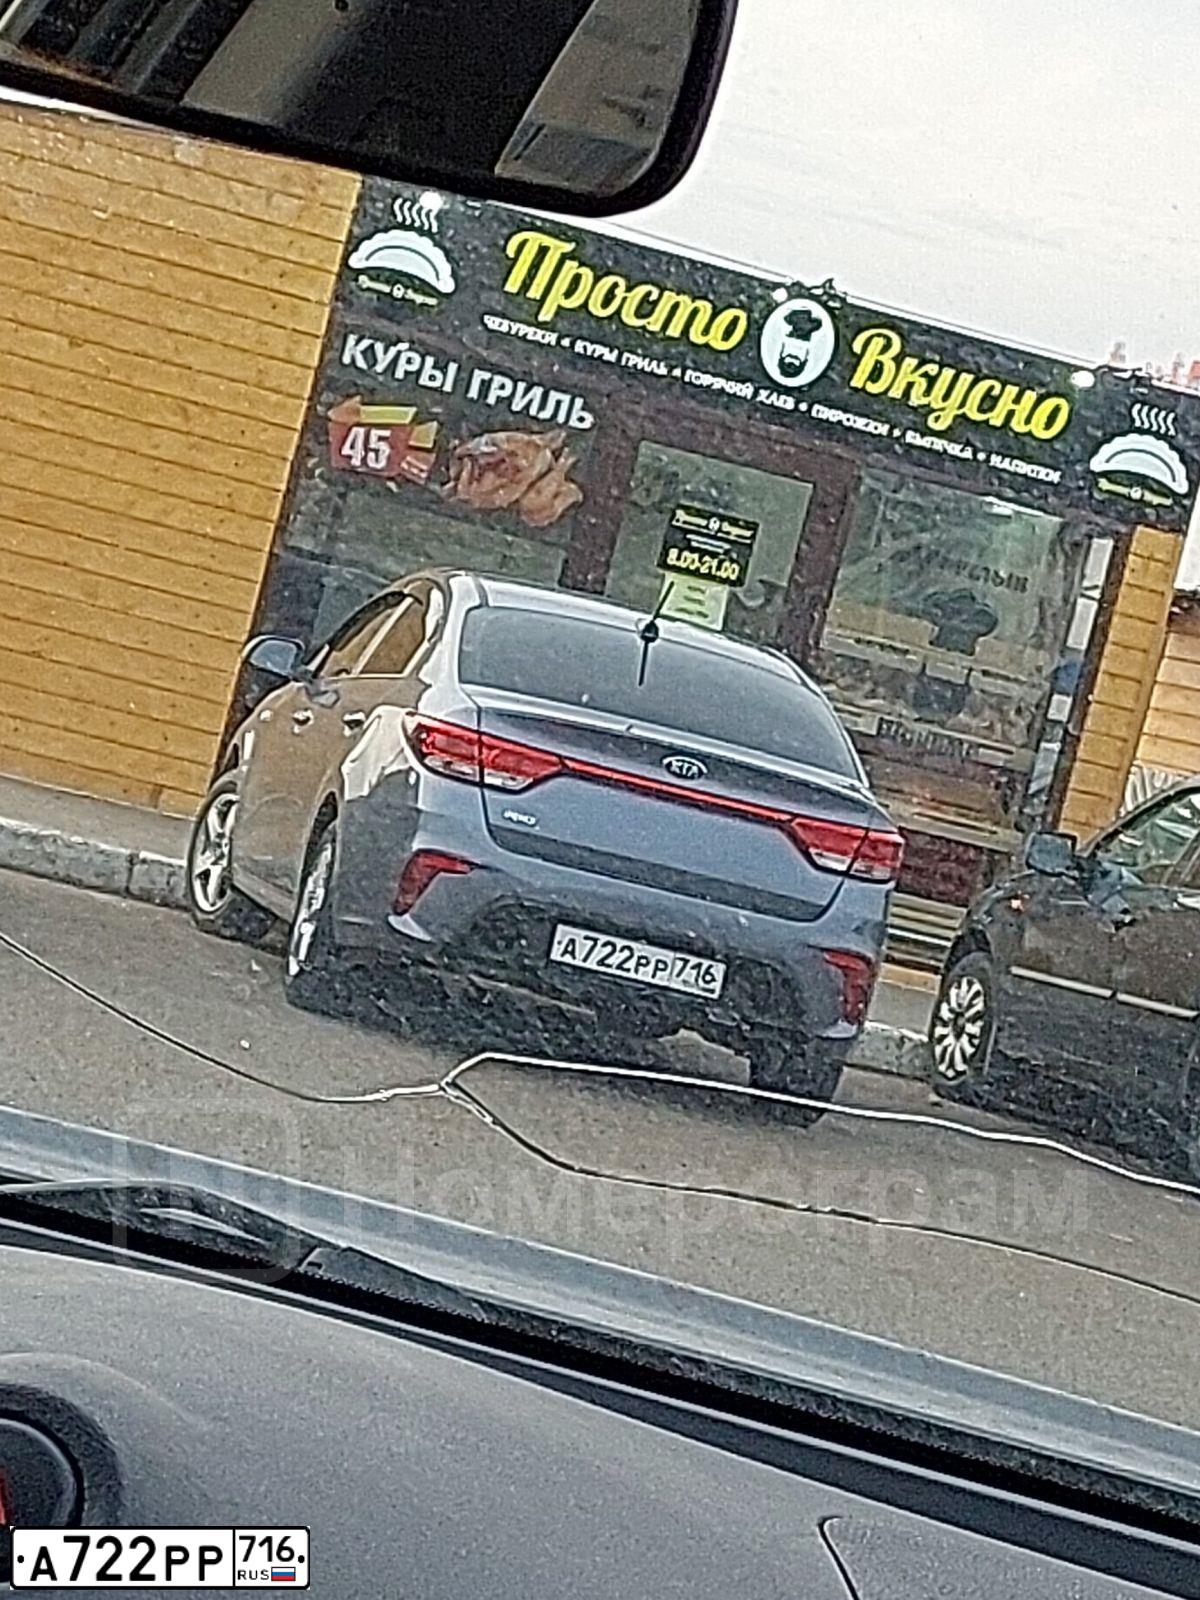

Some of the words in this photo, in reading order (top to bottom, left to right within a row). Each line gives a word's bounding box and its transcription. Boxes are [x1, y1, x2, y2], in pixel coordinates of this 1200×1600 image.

[504, 231, 748, 351] Просто
[852, 328, 1071, 440] Вкусно
[574, 339, 619, 363] КУРЫ
[621, 352, 669, 376] ГРИЛЬ
[341, 334, 459, 393] КУРЫ
[466, 369, 596, 431] ГРИЛЬ
[341, 426, 391, 469] 45
